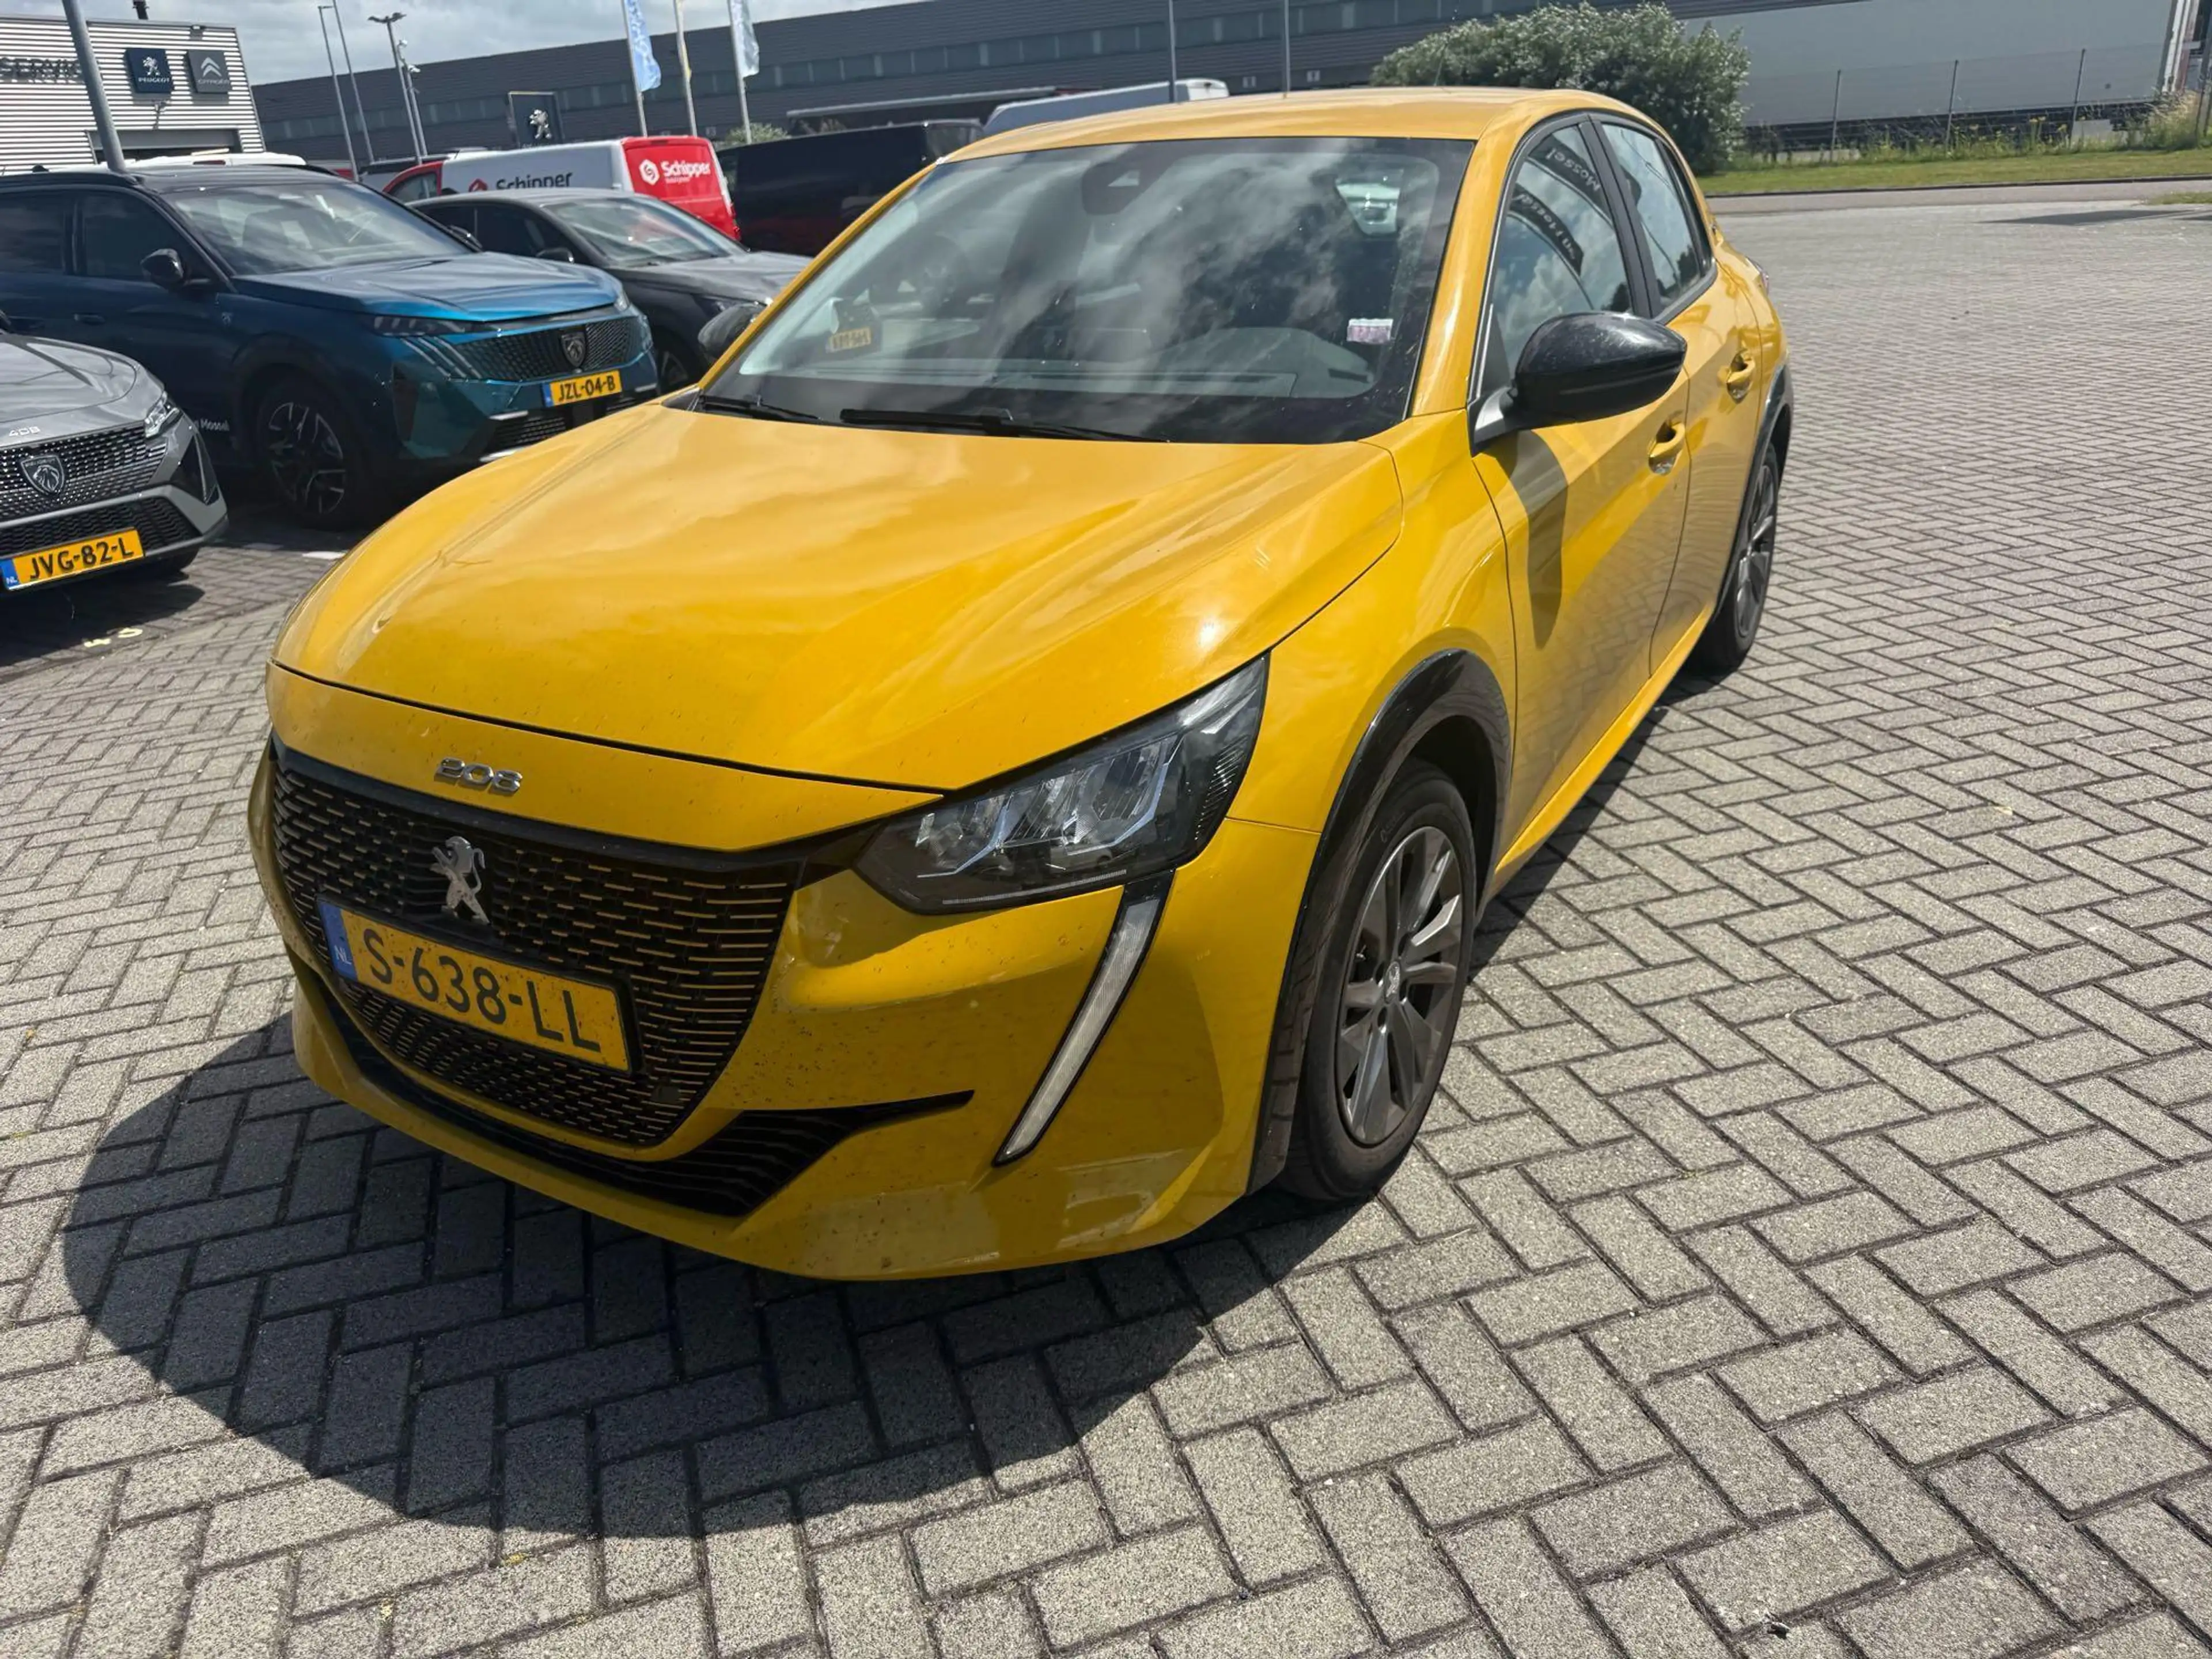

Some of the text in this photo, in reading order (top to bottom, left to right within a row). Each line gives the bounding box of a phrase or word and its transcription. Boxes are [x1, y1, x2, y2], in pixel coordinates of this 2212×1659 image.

[558, 375, 616, 402] JZL-04-B
[29, 537, 134, 579] JVG-82-L
[435, 757, 523, 795] 208
[363, 928, 601, 1053] S-638-LL
